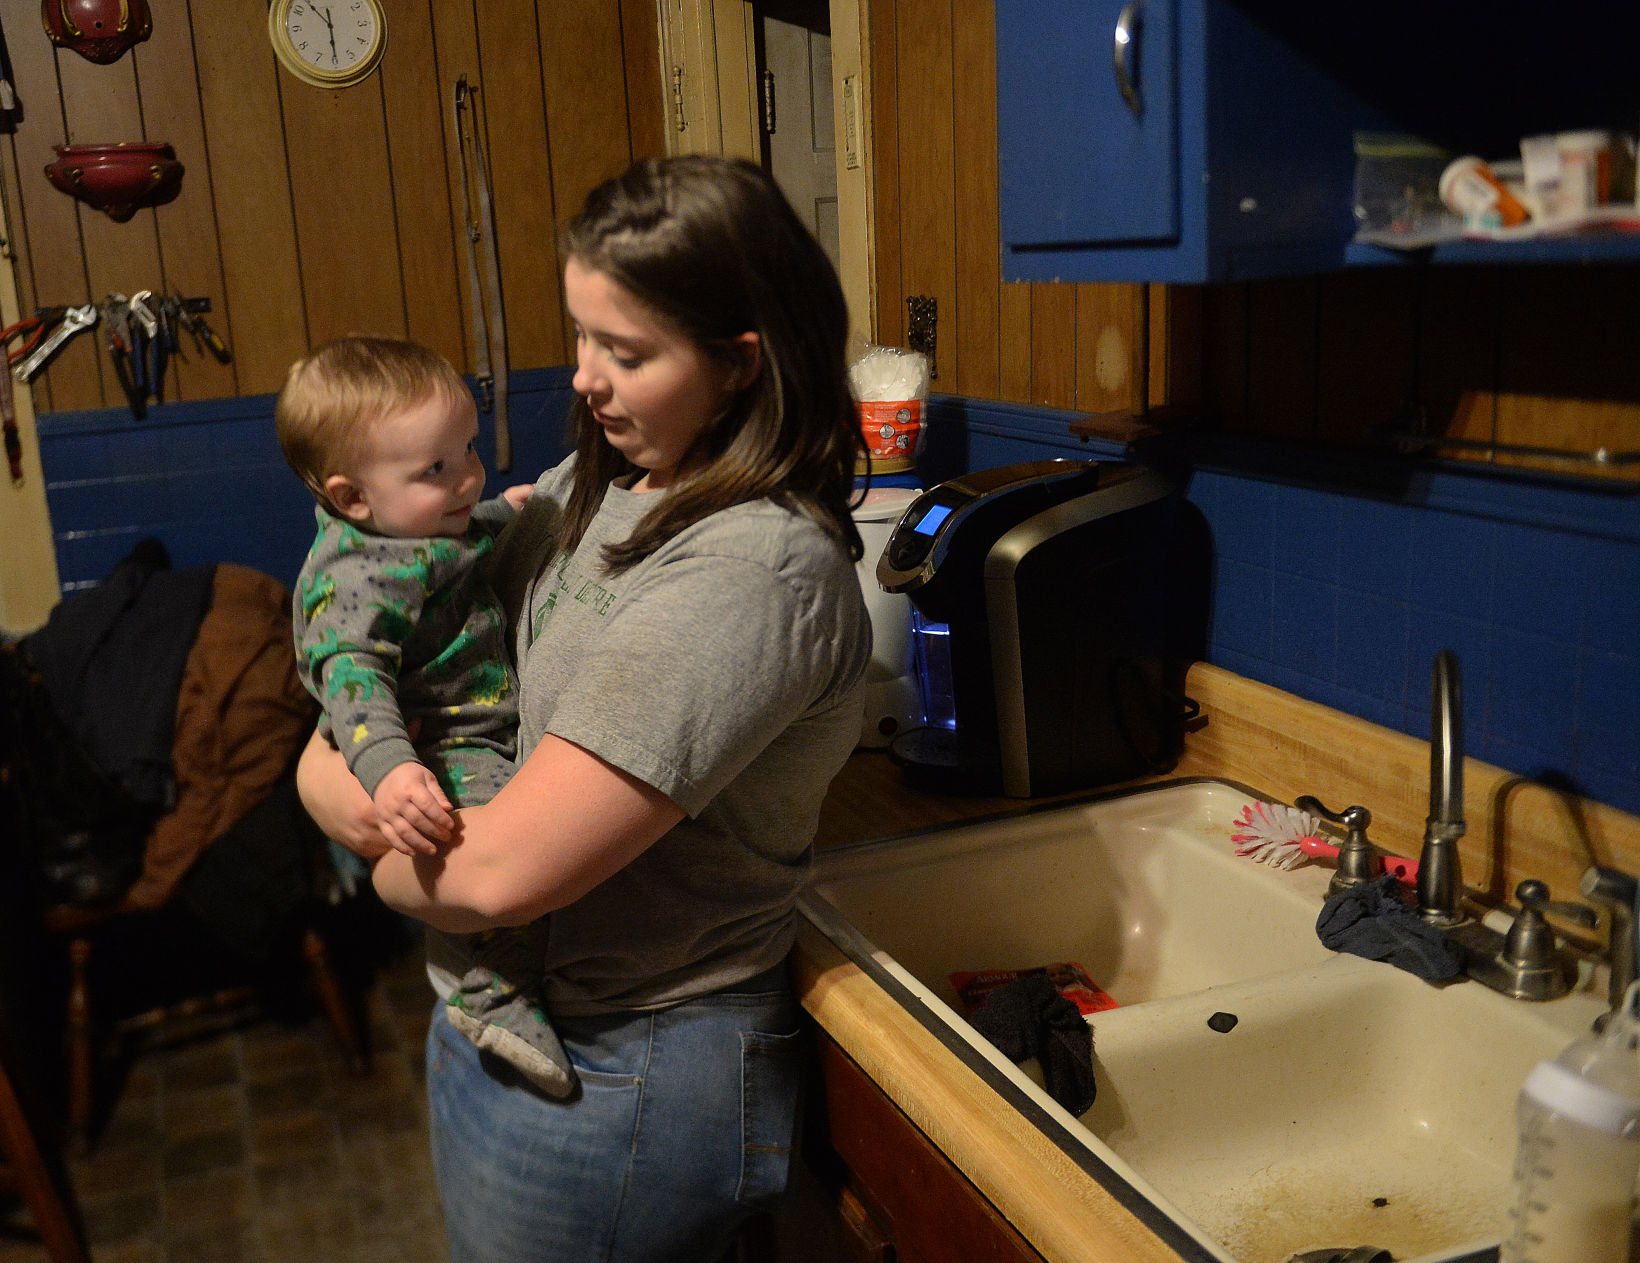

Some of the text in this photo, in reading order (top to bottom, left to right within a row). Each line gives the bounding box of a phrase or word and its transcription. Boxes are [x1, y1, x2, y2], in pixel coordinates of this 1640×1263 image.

[293, 5, 304, 16] 10
[350, 2, 361, 11] 2
[298, 41, 308, 50] 8
[357, 37, 367, 45] 4
[314, 52, 322, 64] 7
[346, 49, 356, 61] 5
